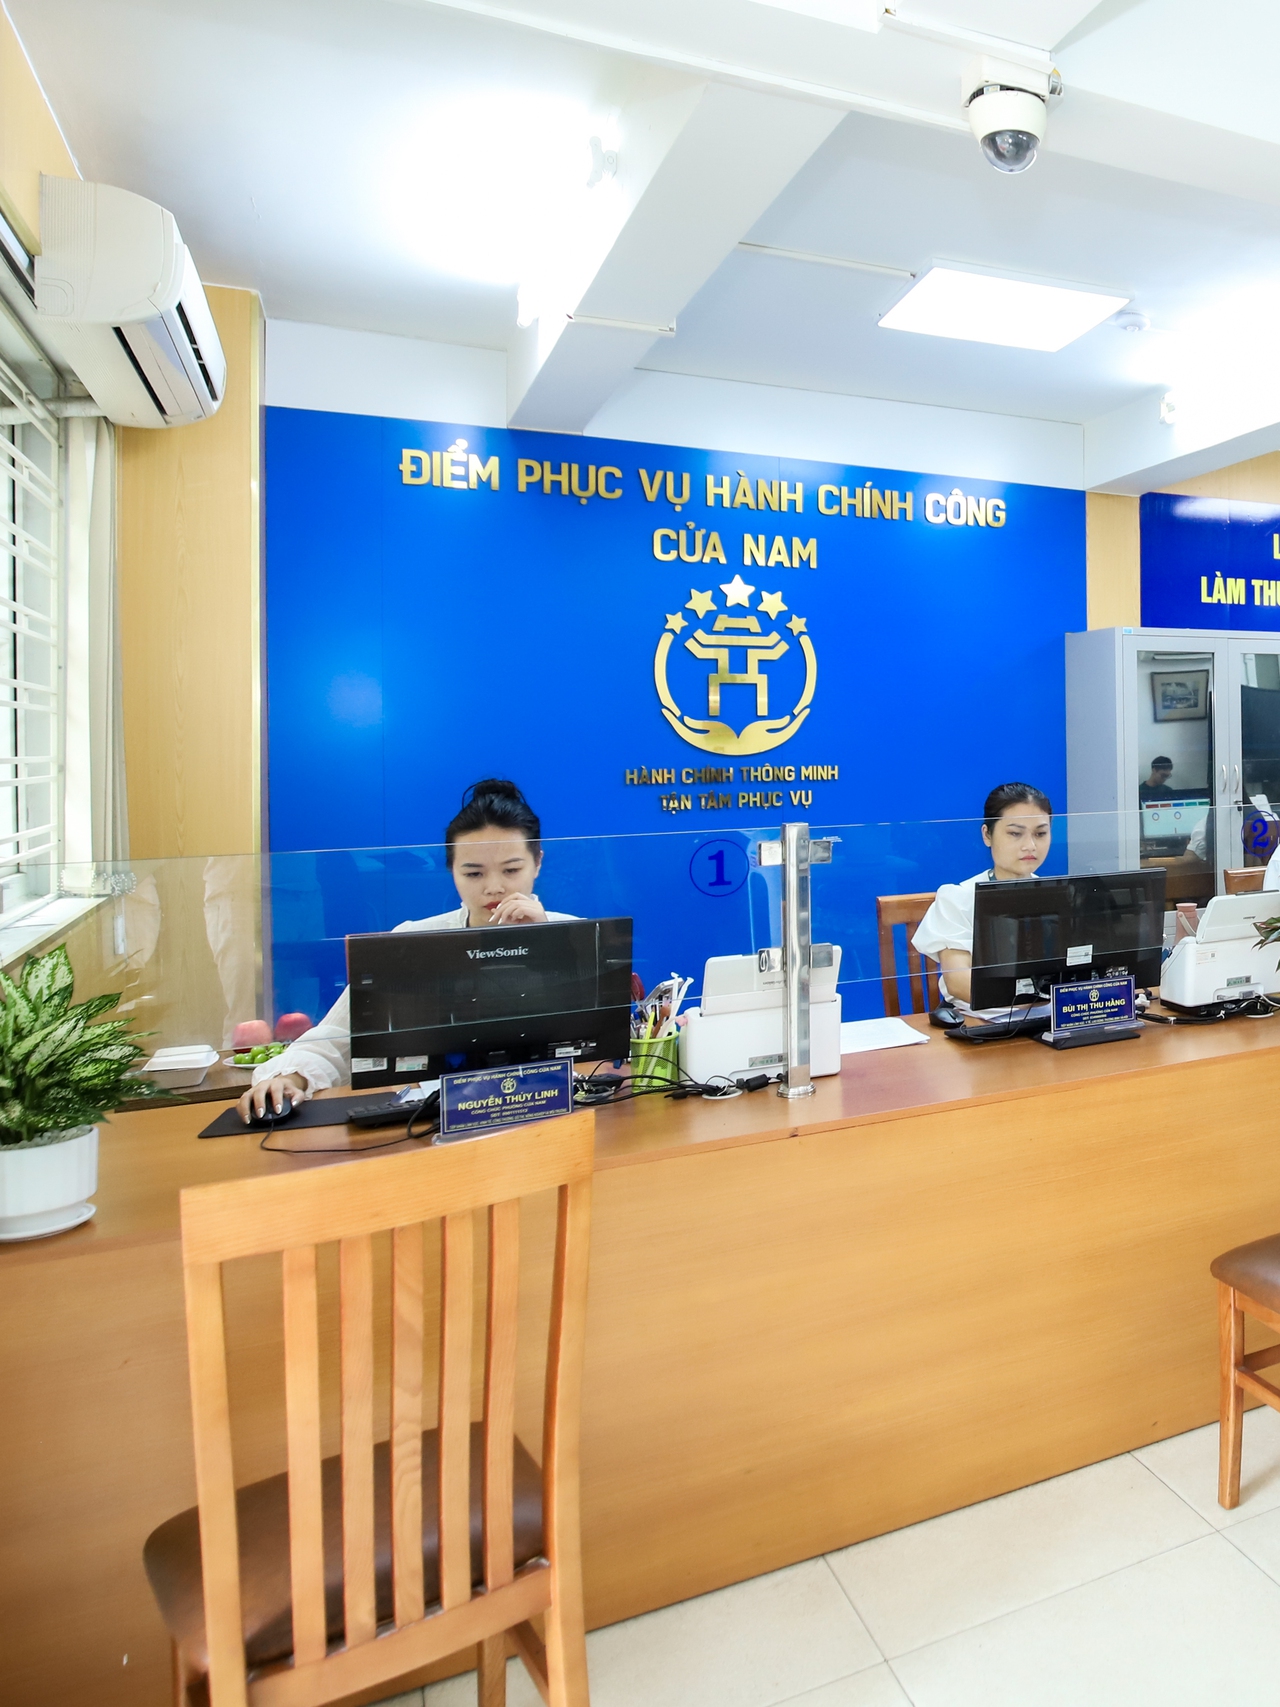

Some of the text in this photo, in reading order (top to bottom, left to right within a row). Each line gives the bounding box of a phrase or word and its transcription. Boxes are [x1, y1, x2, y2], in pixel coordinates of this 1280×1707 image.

[399, 438, 1006, 527] ĐIỂM PHỤC VỤ HÀNH CHÍNH CÔNG
[653, 521, 817, 569] CỬA NAM
[1200, 571, 1245, 605] LÀM
[625, 763, 839, 785] HÀNH CHÍNH THÔNG MINH
[660, 790, 812, 814] TẬN TÂM PHỤC VỤ
[1252, 818, 1270, 848] 2
[708, 850, 732, 886] 1
[466, 946, 529, 960] ViewSonic
[1089, 1001, 1104, 1009] THU
[458, 1095, 502, 1111] NGUYỄN
[535, 1089, 558, 1100] LINH
